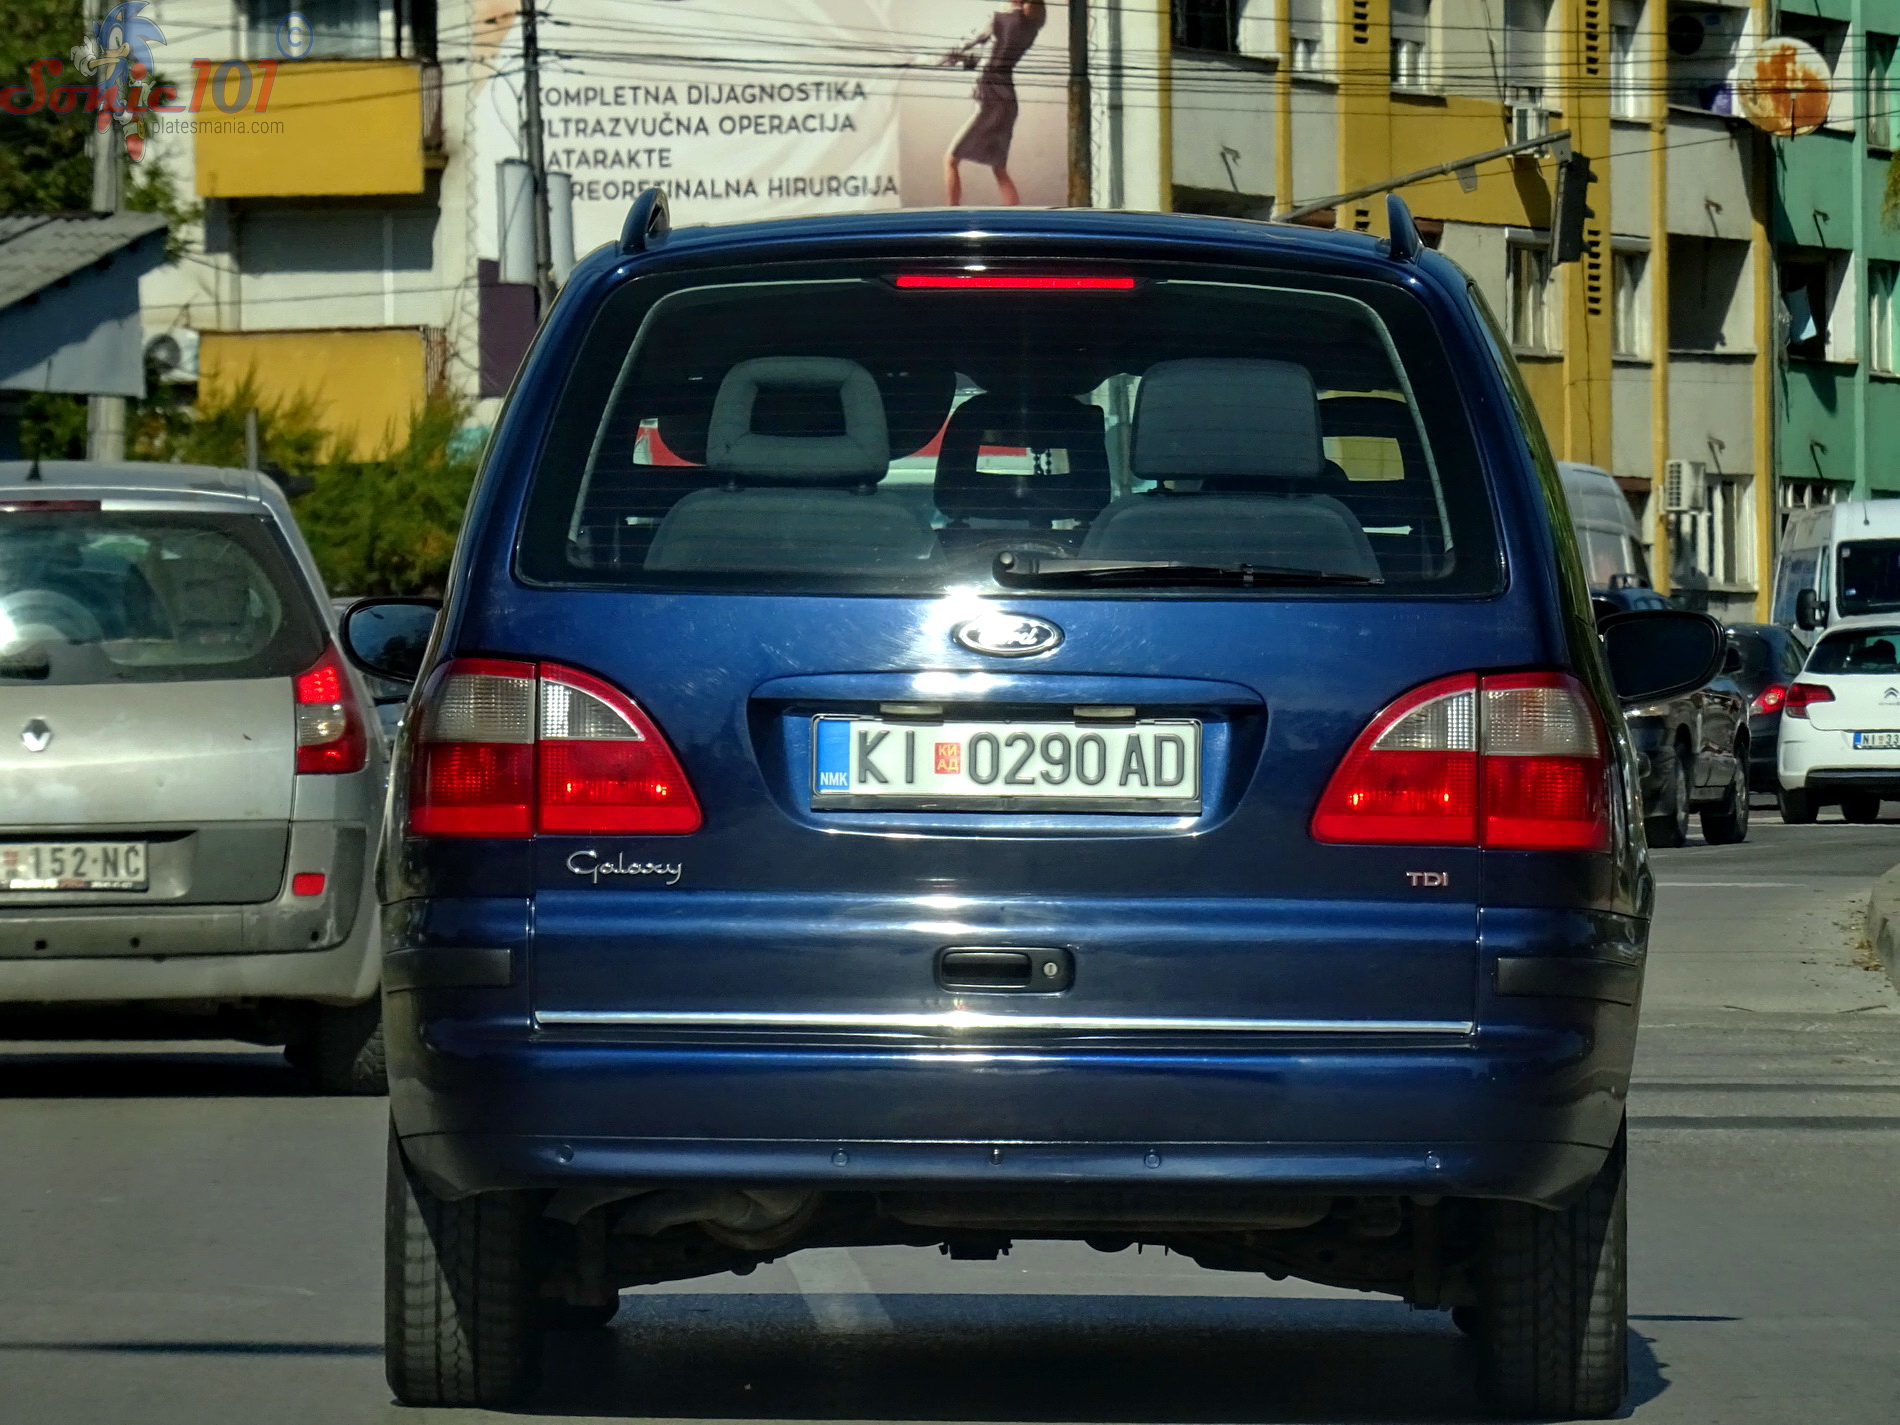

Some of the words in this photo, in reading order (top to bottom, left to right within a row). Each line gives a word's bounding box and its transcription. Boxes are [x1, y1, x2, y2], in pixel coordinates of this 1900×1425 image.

[687, 81, 867, 106] DIJAGNOSTIKA
[545, 111, 709, 138] LTRAZVUČNA
[718, 113, 855, 136] OPERACIJA
[548, 148, 672, 168] ATARAKTE
[767, 175, 898, 197] HIRURGIJA
[1886, 734, 1899, 745] 33
[857, 730, 915, 784] KI
[968, 731, 1107, 786] 0290
[1119, 732, 1185, 787] AD
[819, 772, 848, 787] NMK
[566, 850, 682, 885] Galaxy
[1406, 871, 1449, 887] TDI
